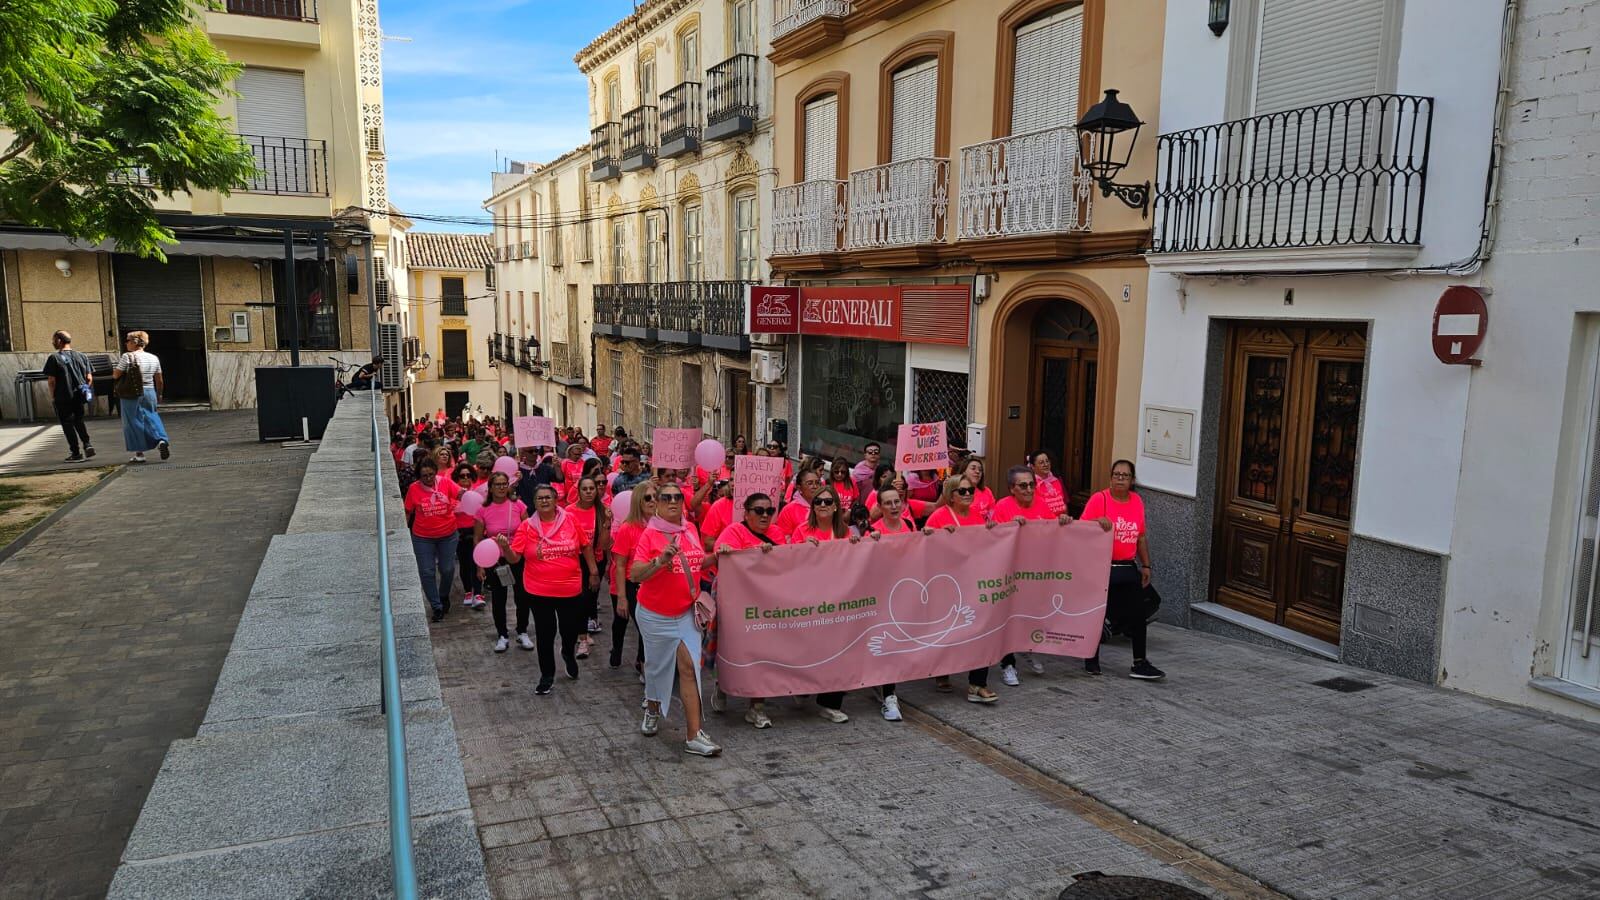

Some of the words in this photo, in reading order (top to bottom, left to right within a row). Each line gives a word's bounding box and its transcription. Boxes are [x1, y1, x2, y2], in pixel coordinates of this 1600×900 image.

[1124, 287, 1129, 298] 6
[1285, 289, 1292, 305] 4
[822, 299, 893, 327] GENERALI
[757, 317, 791, 325] GENERALI
[917, 435, 940, 449] UNAS
[903, 451, 947, 464] GUERRERAS
[978, 579, 1002, 590] nos
[1013, 571, 1073, 581] omamos
[979, 593, 988, 603] a
[745, 607, 759, 619] El
[762, 606, 815, 619] cáncer
[817, 601, 835, 614] de
[838, 596, 877, 611] mama
[745, 624, 751, 632] y
[752, 621, 777, 631] cómo
[778, 622, 788, 630] lo
[788, 619, 811, 629] viven
[812, 617, 834, 626] miles
[834, 615, 845, 624] de
[846, 609, 878, 622] personas
